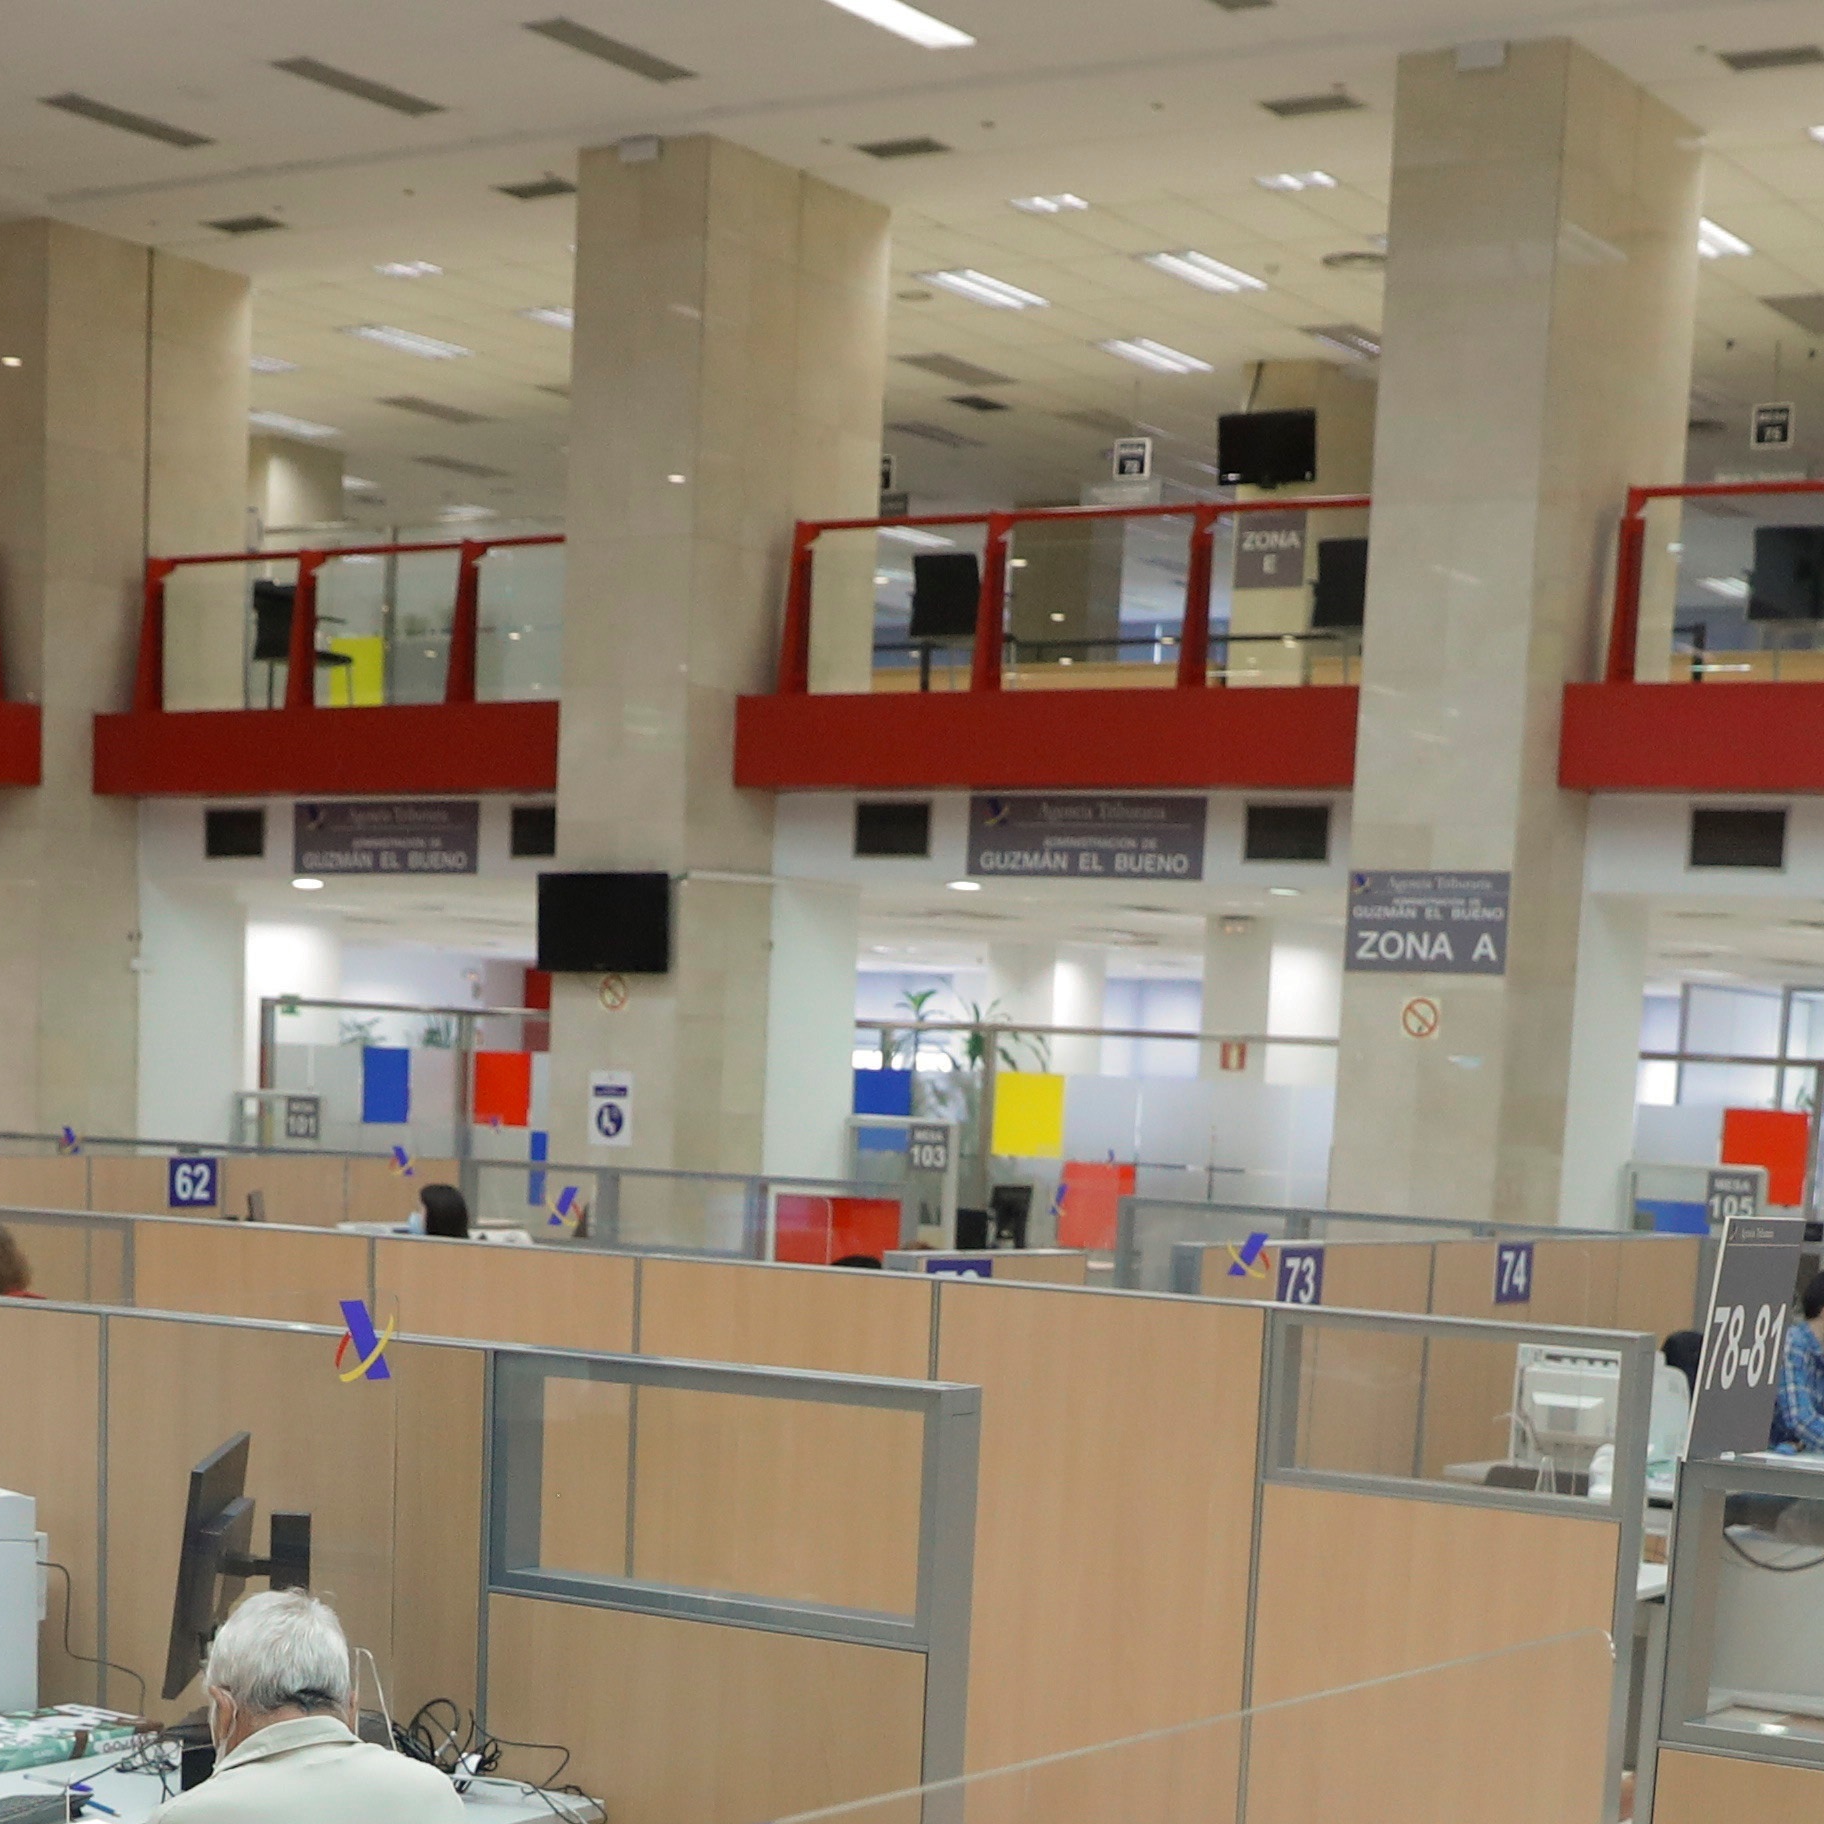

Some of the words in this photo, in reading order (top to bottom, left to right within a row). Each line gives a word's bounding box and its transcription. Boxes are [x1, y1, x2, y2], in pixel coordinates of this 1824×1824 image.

[1242, 530, 1302, 552] ZONA
[407, 851, 468, 869] BUENO
[979, 849, 1069, 871] GUZMÁN
[1079, 851, 1104, 871] EL
[1114, 852, 1191, 874] BUENO
[1425, 906, 1442, 920] EL
[1451, 906, 1505, 921] BUENO
[1355, 930, 1455, 962] ZONA
[1472, 931, 1498, 962] A
[910, 1144, 946, 1168] 103
[175, 1164, 211, 1200] 62
[1714, 1178, 1751, 1191] MESA
[1709, 1194, 1753, 1218] 105
[1284, 1257, 1316, 1303] 73
[1501, 1250, 1527, 1294] 74
[1704, 1303, 1787, 1391] 78-81
